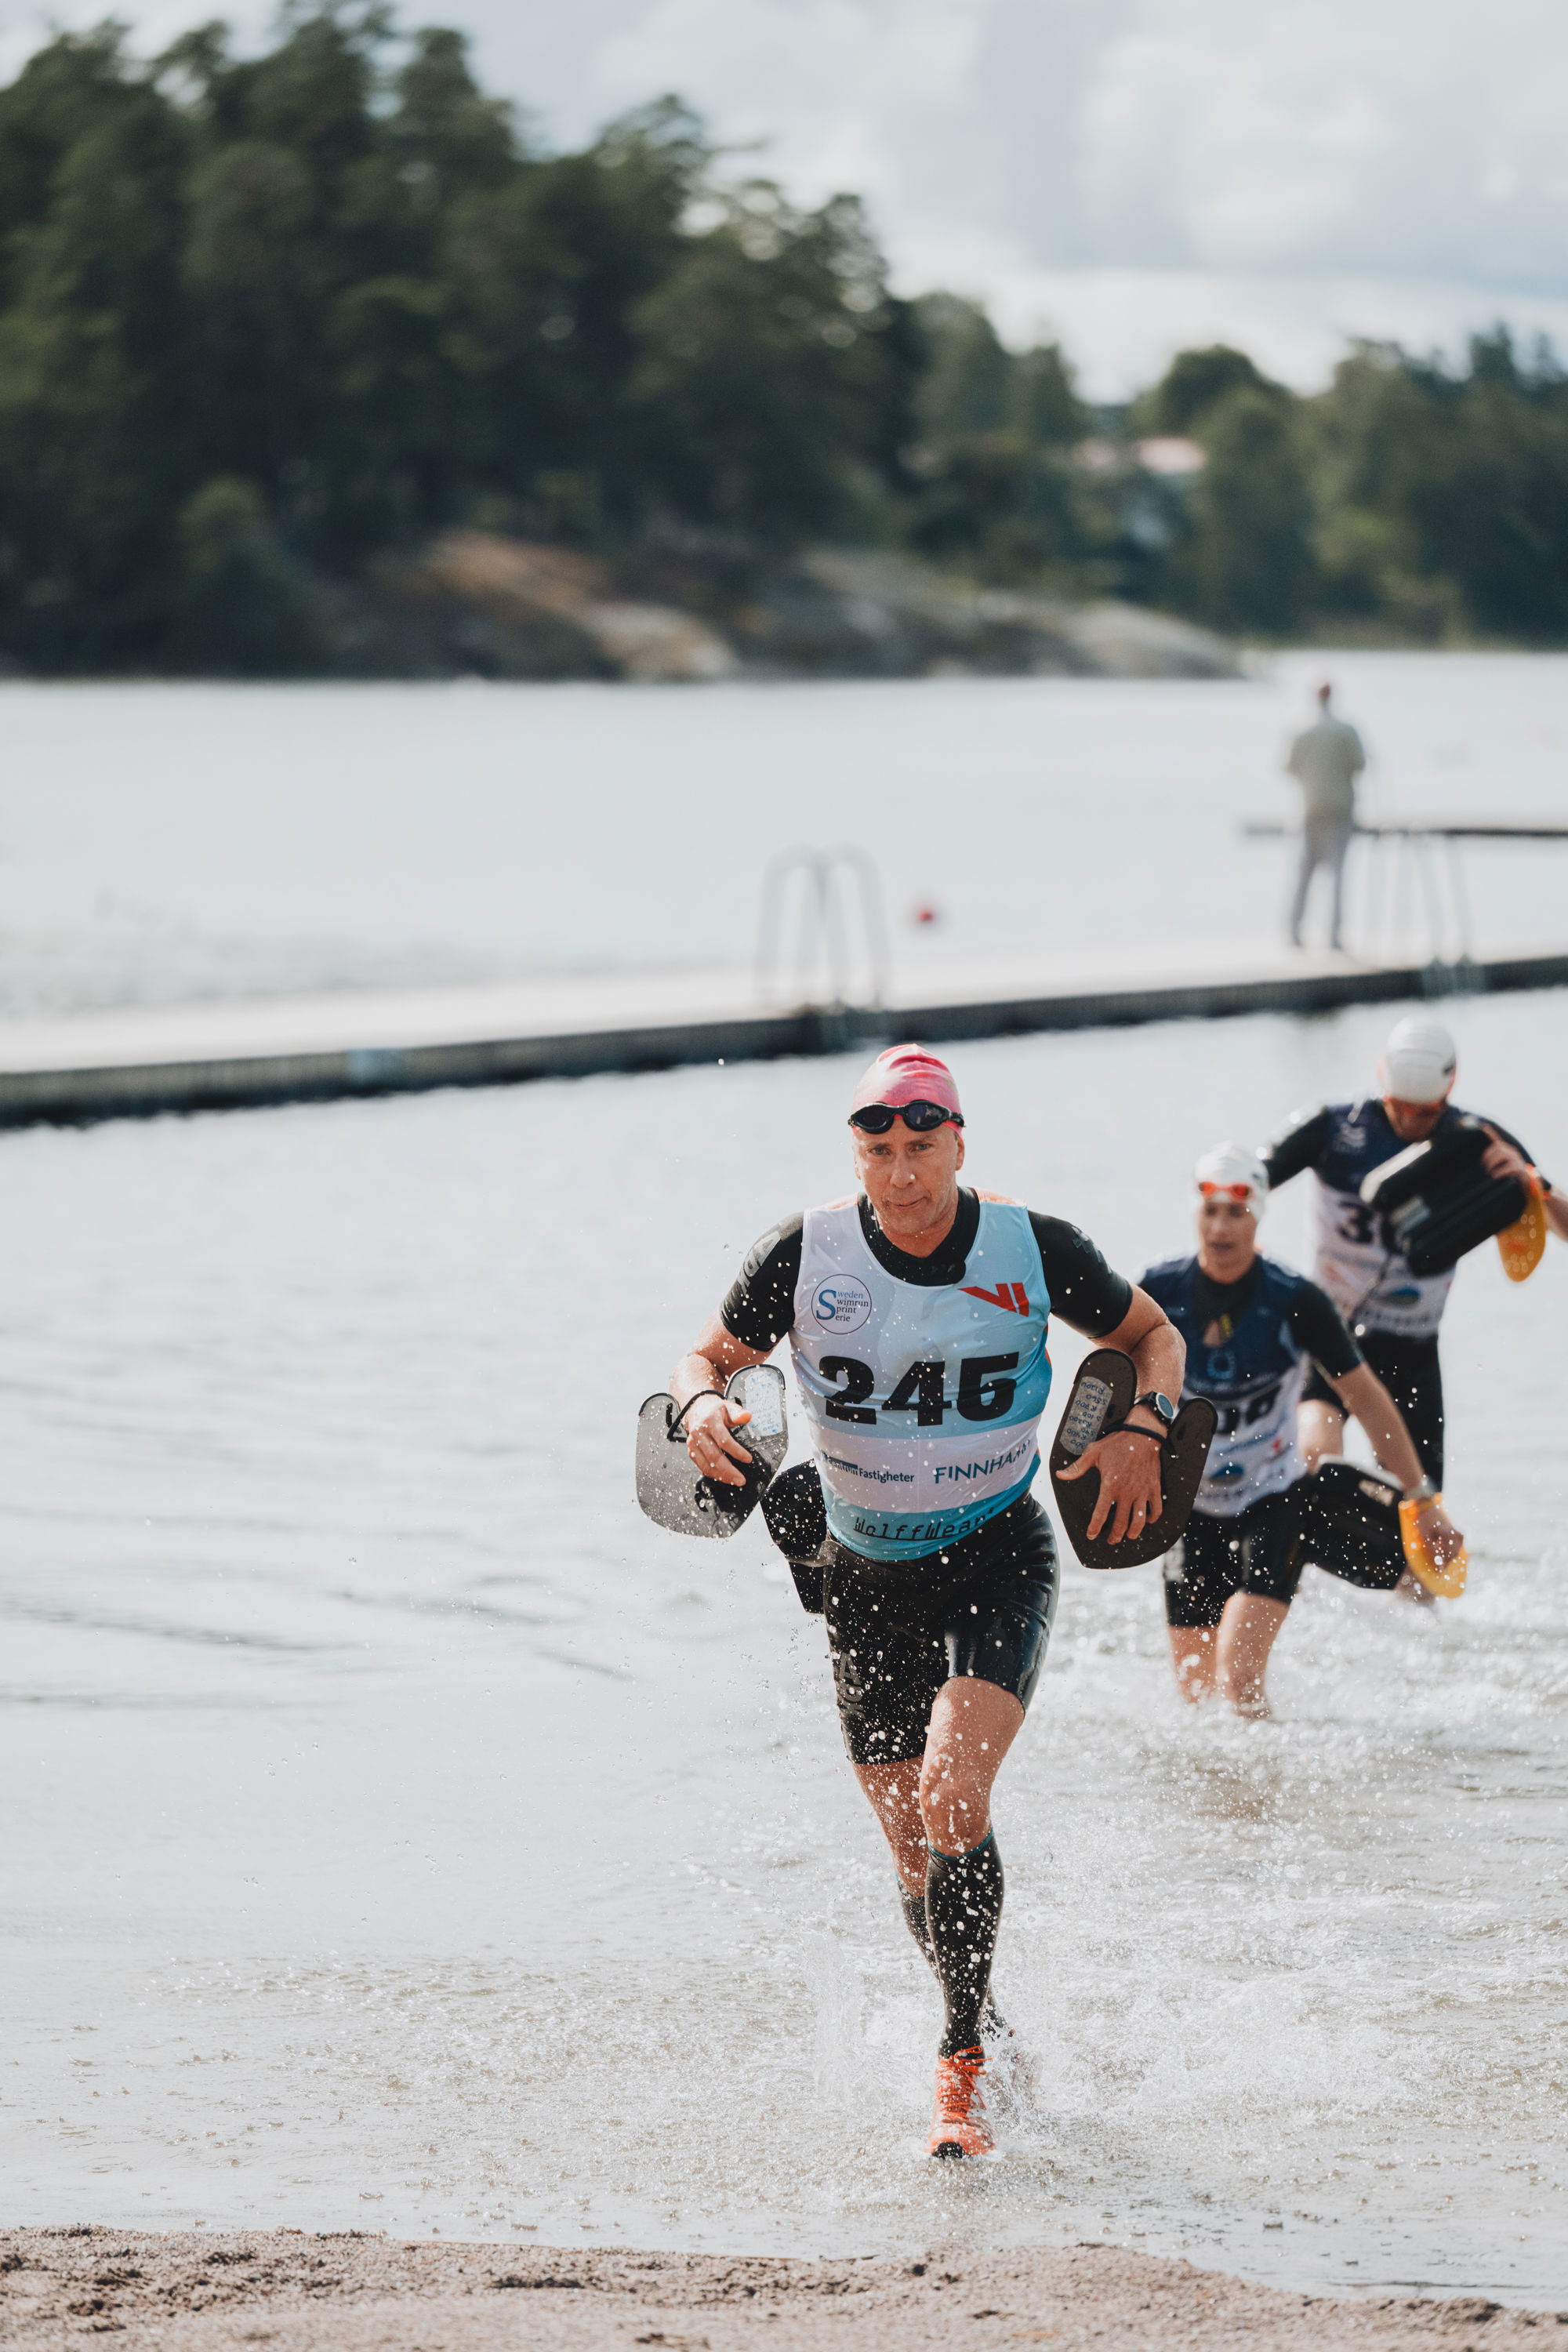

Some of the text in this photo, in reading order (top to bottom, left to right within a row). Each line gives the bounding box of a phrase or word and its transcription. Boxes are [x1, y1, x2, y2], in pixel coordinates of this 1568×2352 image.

[819, 1352, 1019, 1427] 245
[858, 1468, 915, 1484] Fastigheter
[934, 1439, 1030, 1484] FINNHA
